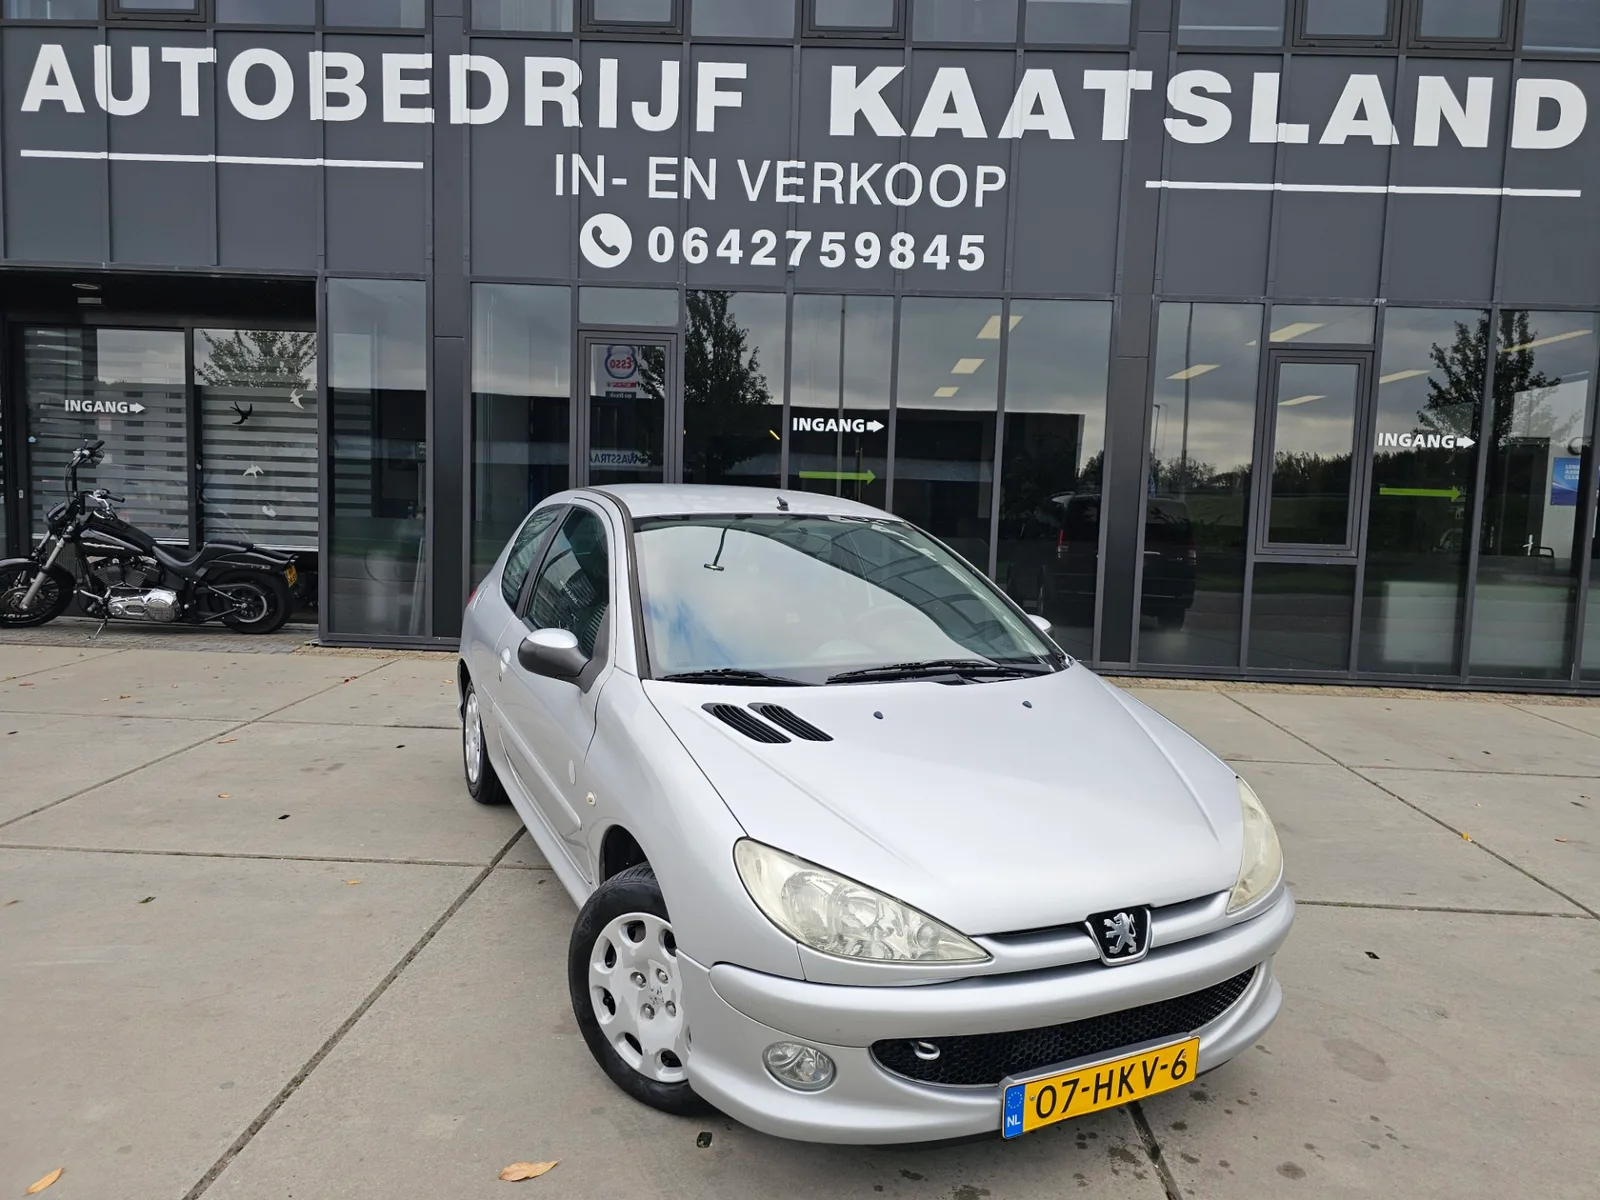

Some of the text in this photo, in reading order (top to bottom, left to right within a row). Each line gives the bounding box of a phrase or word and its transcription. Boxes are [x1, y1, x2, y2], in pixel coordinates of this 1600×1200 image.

[20, 43, 1588, 149] AUTOBEDRIJF KAATSLAND
[555, 153, 1006, 208] IN- EN VERKOOP
[648, 226, 985, 270] 0642759845
[64, 399, 128, 414] INGANG
[792, 417, 865, 433] INGANG
[1378, 432, 1455, 449] INGANG
[1036, 1048, 1187, 1119] 07-HKV-6
[1006, 1114, 1021, 1128] NL
